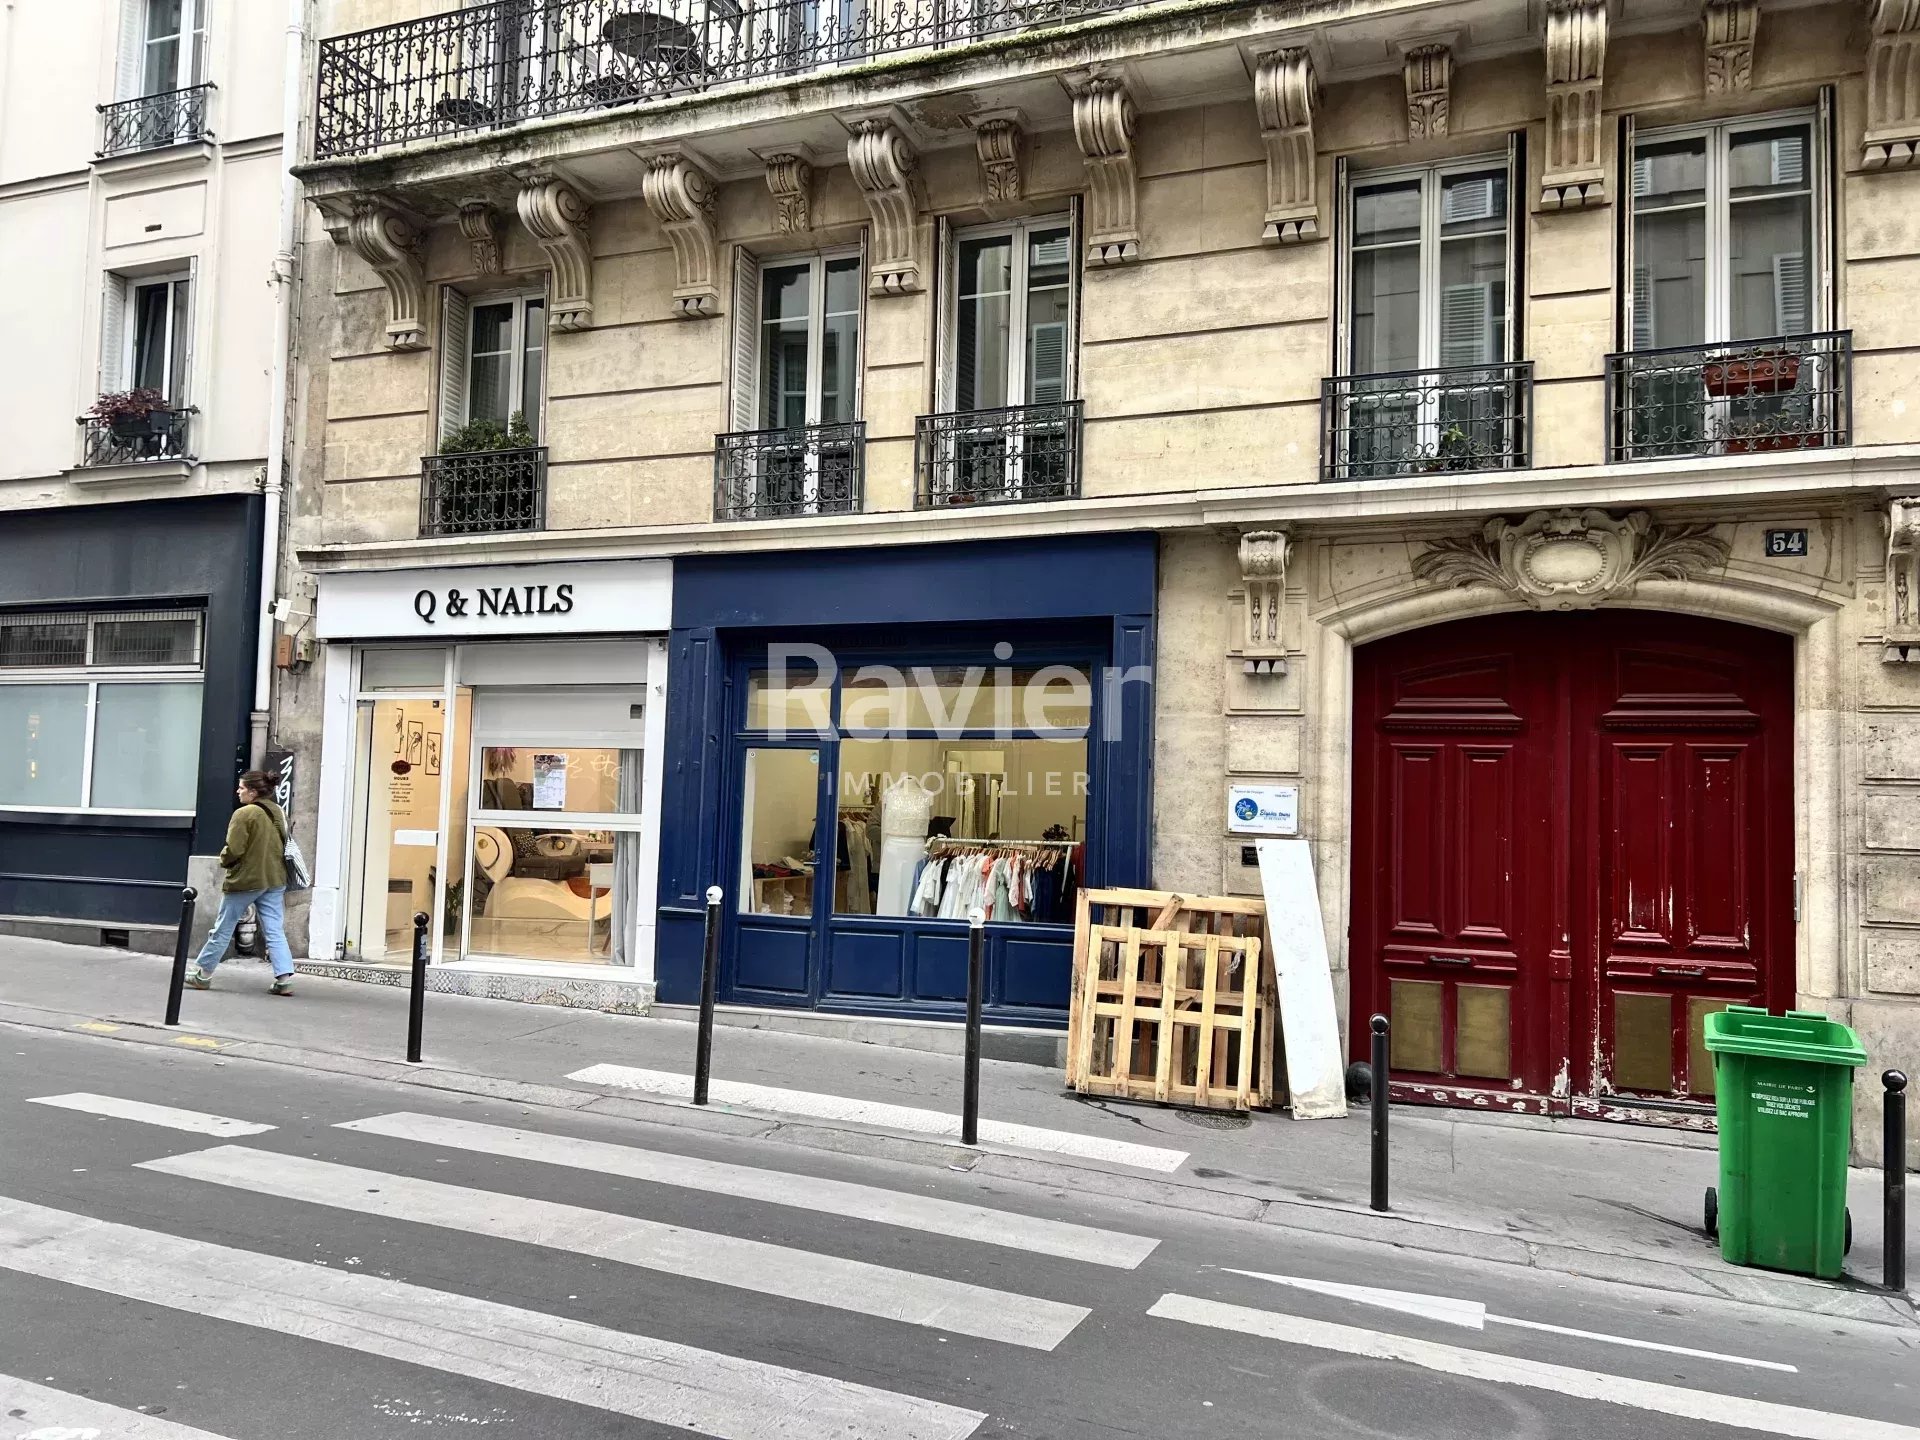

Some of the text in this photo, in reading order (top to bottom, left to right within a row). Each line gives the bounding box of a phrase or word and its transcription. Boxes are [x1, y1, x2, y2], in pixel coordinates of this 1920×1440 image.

[1772, 532, 1803, 553] 54
[414, 584, 574, 624] Q & NAILS
